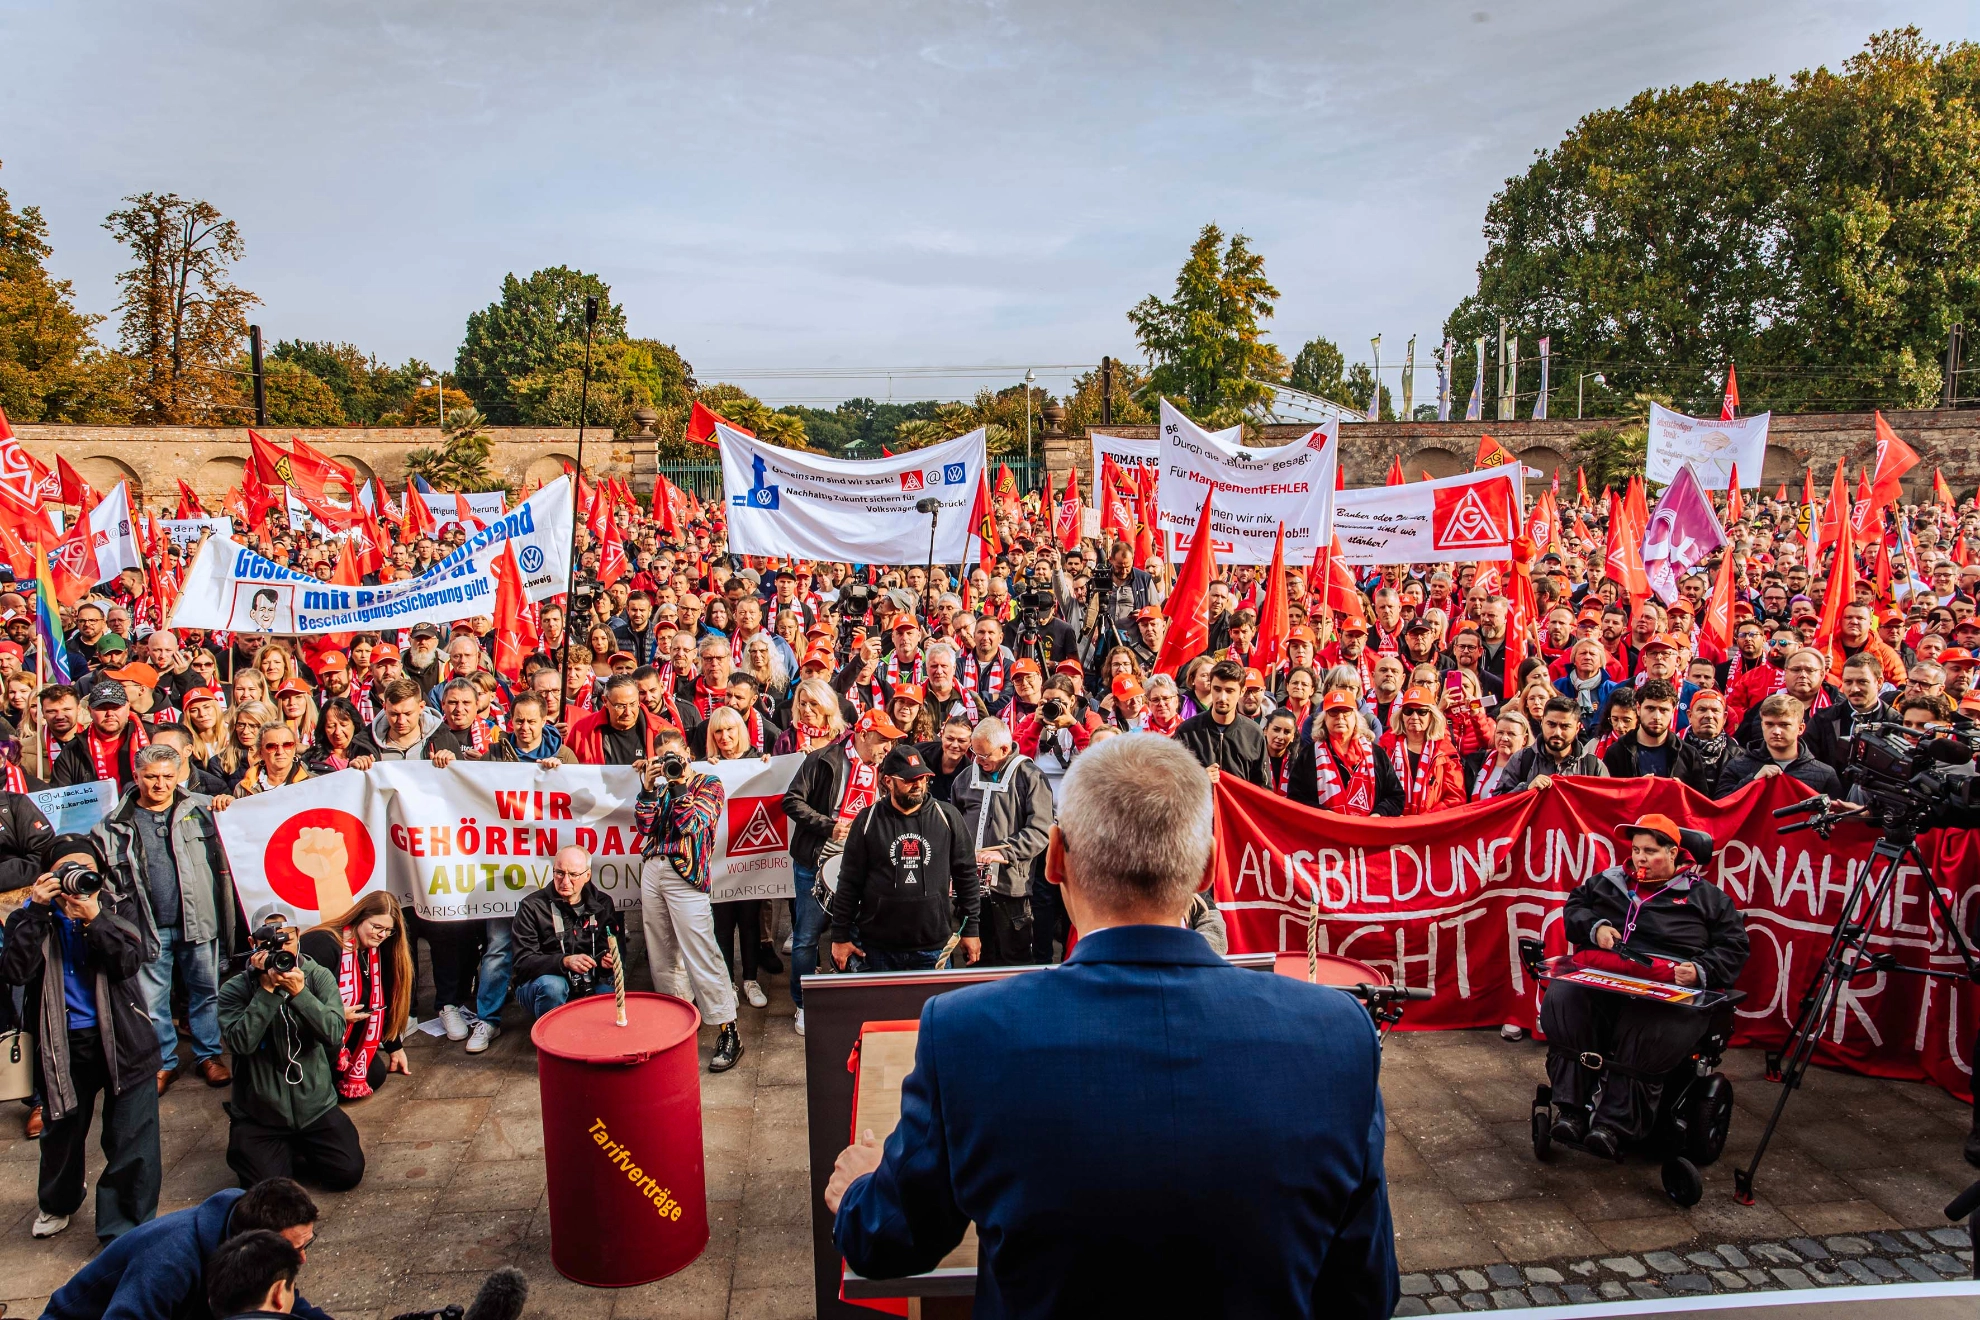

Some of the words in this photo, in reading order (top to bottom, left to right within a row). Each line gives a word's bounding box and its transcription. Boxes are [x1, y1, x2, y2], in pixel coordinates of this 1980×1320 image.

[1166, 424, 1179, 435] B6
[1146, 457, 1159, 467] SC
[1172, 435, 1203, 455] Durch
[1204, 448, 1220, 462] die
[1272, 453, 1312, 472] gesagt:
[827, 476, 846, 485] sind
[865, 476, 894, 486] stark!
[1169, 465, 1188, 479] Für
[1189, 470, 1309, 494] ManagementFEHLER
[786, 487, 833, 502] Nachhaltig
[834, 493, 868, 504] Zukunft
[869, 493, 901, 503] sichern
[903, 493, 915, 502] für
[1195, 502, 1234, 521] knnen
[1236, 514, 1254, 524] wir
[1256, 512, 1276, 524] nix.
[1336, 508, 1370, 520] Banker
[1373, 513, 1393, 522] oder
[1160, 511, 1196, 527] Macht
[1209, 522, 1240, 536] dlich
[1243, 529, 1277, 538] euren
[1285, 527, 1310, 538] ob!!!
[1377, 525, 1399, 534] sind
[1400, 527, 1417, 537] wir
[1347, 536, 1388, 549] stärker!
[523, 574, 552, 589] chweig
[298, 581, 463, 631] Beschäftigungssicherung
[464, 576, 490, 602] gilt!
[304, 589, 351, 611] mit
[494, 790, 573, 821] WIR
[390, 817, 558, 857] GEHÖREN
[575, 826, 646, 857] DAZ
[727, 857, 788, 874] WOLFSBURG
[1234, 837, 1513, 910] AUSBILDUNG
[1524, 826, 1616, 886] UND
[428, 863, 642, 895] AUTOVON
[483, 901, 520, 915] SOLI
[588, 1117, 682, 1221] Tarifverträge
